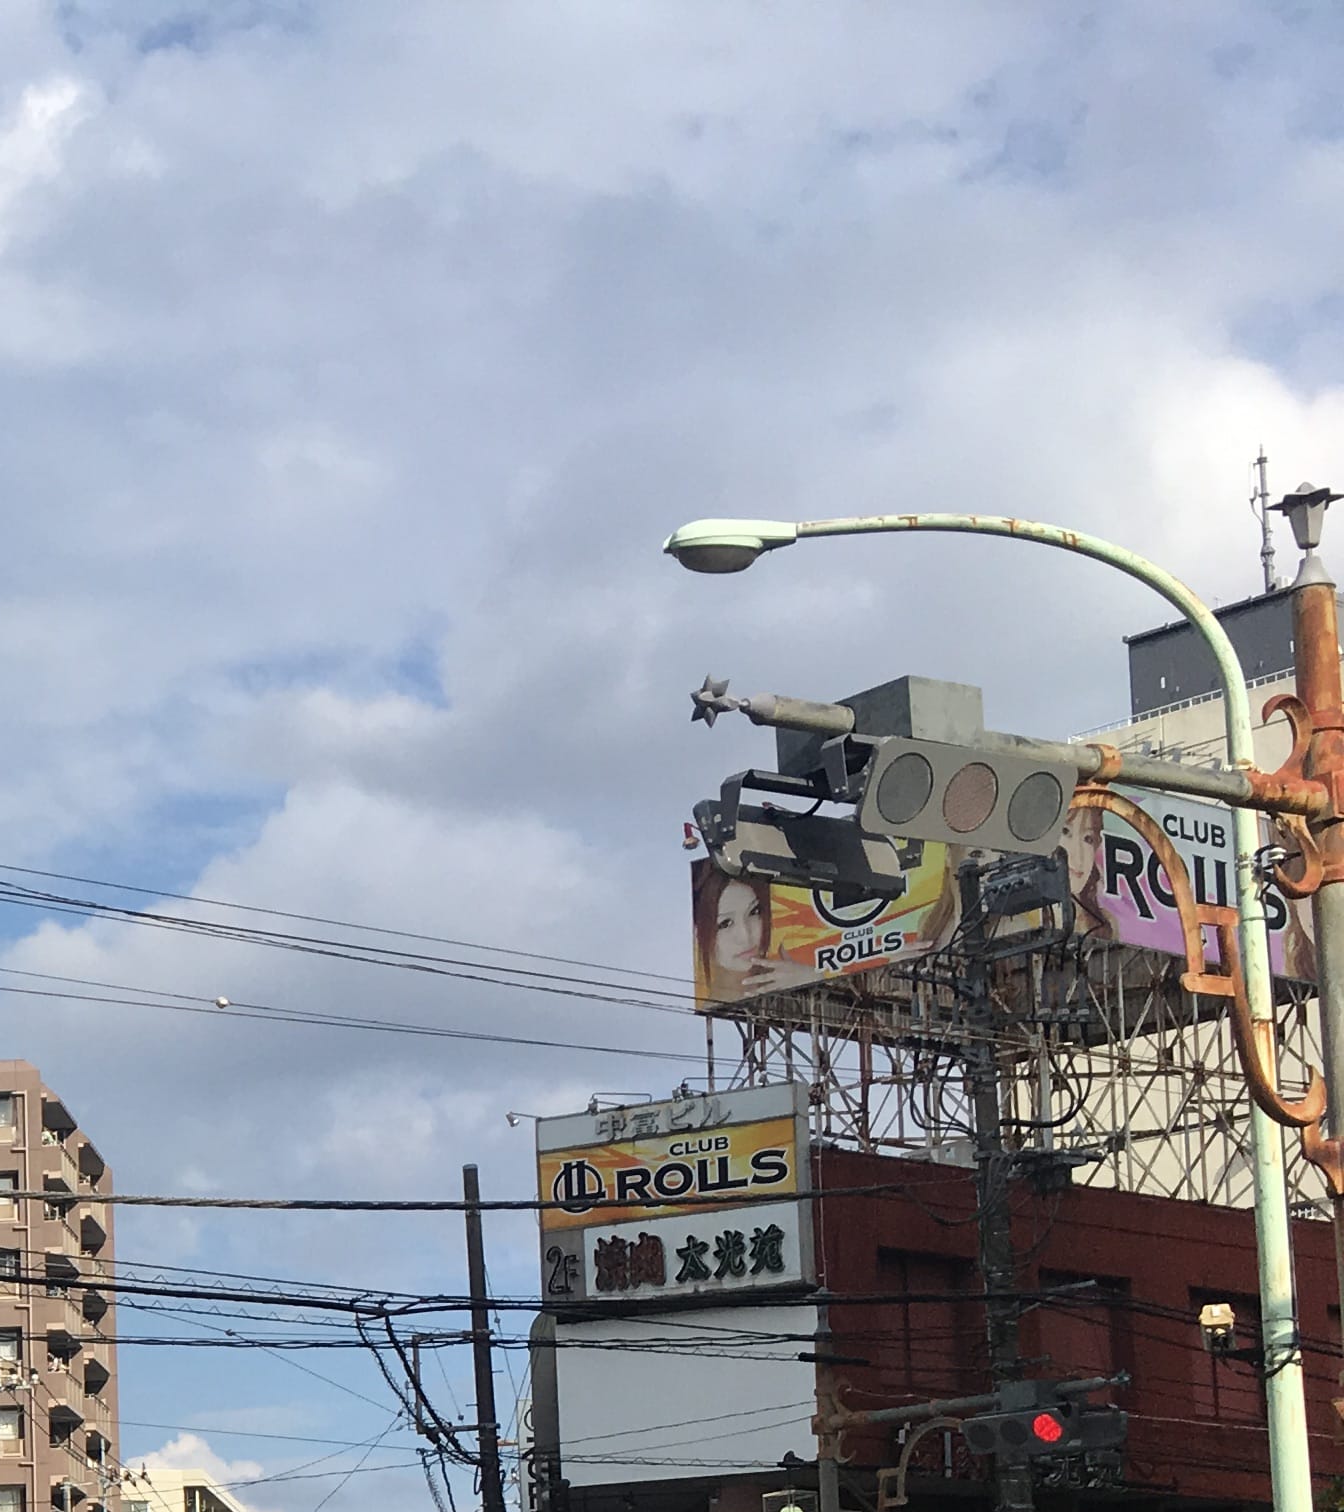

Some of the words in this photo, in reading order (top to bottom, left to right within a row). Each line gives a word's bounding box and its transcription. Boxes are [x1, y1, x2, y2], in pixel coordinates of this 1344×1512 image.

[1163, 814, 1226, 848] CLUB
[843, 926, 874, 940] CLUB
[817, 931, 903, 971] ROLLS
[669, 1136, 729, 1156] CLUB
[616, 1150, 790, 1206] ROLLS
